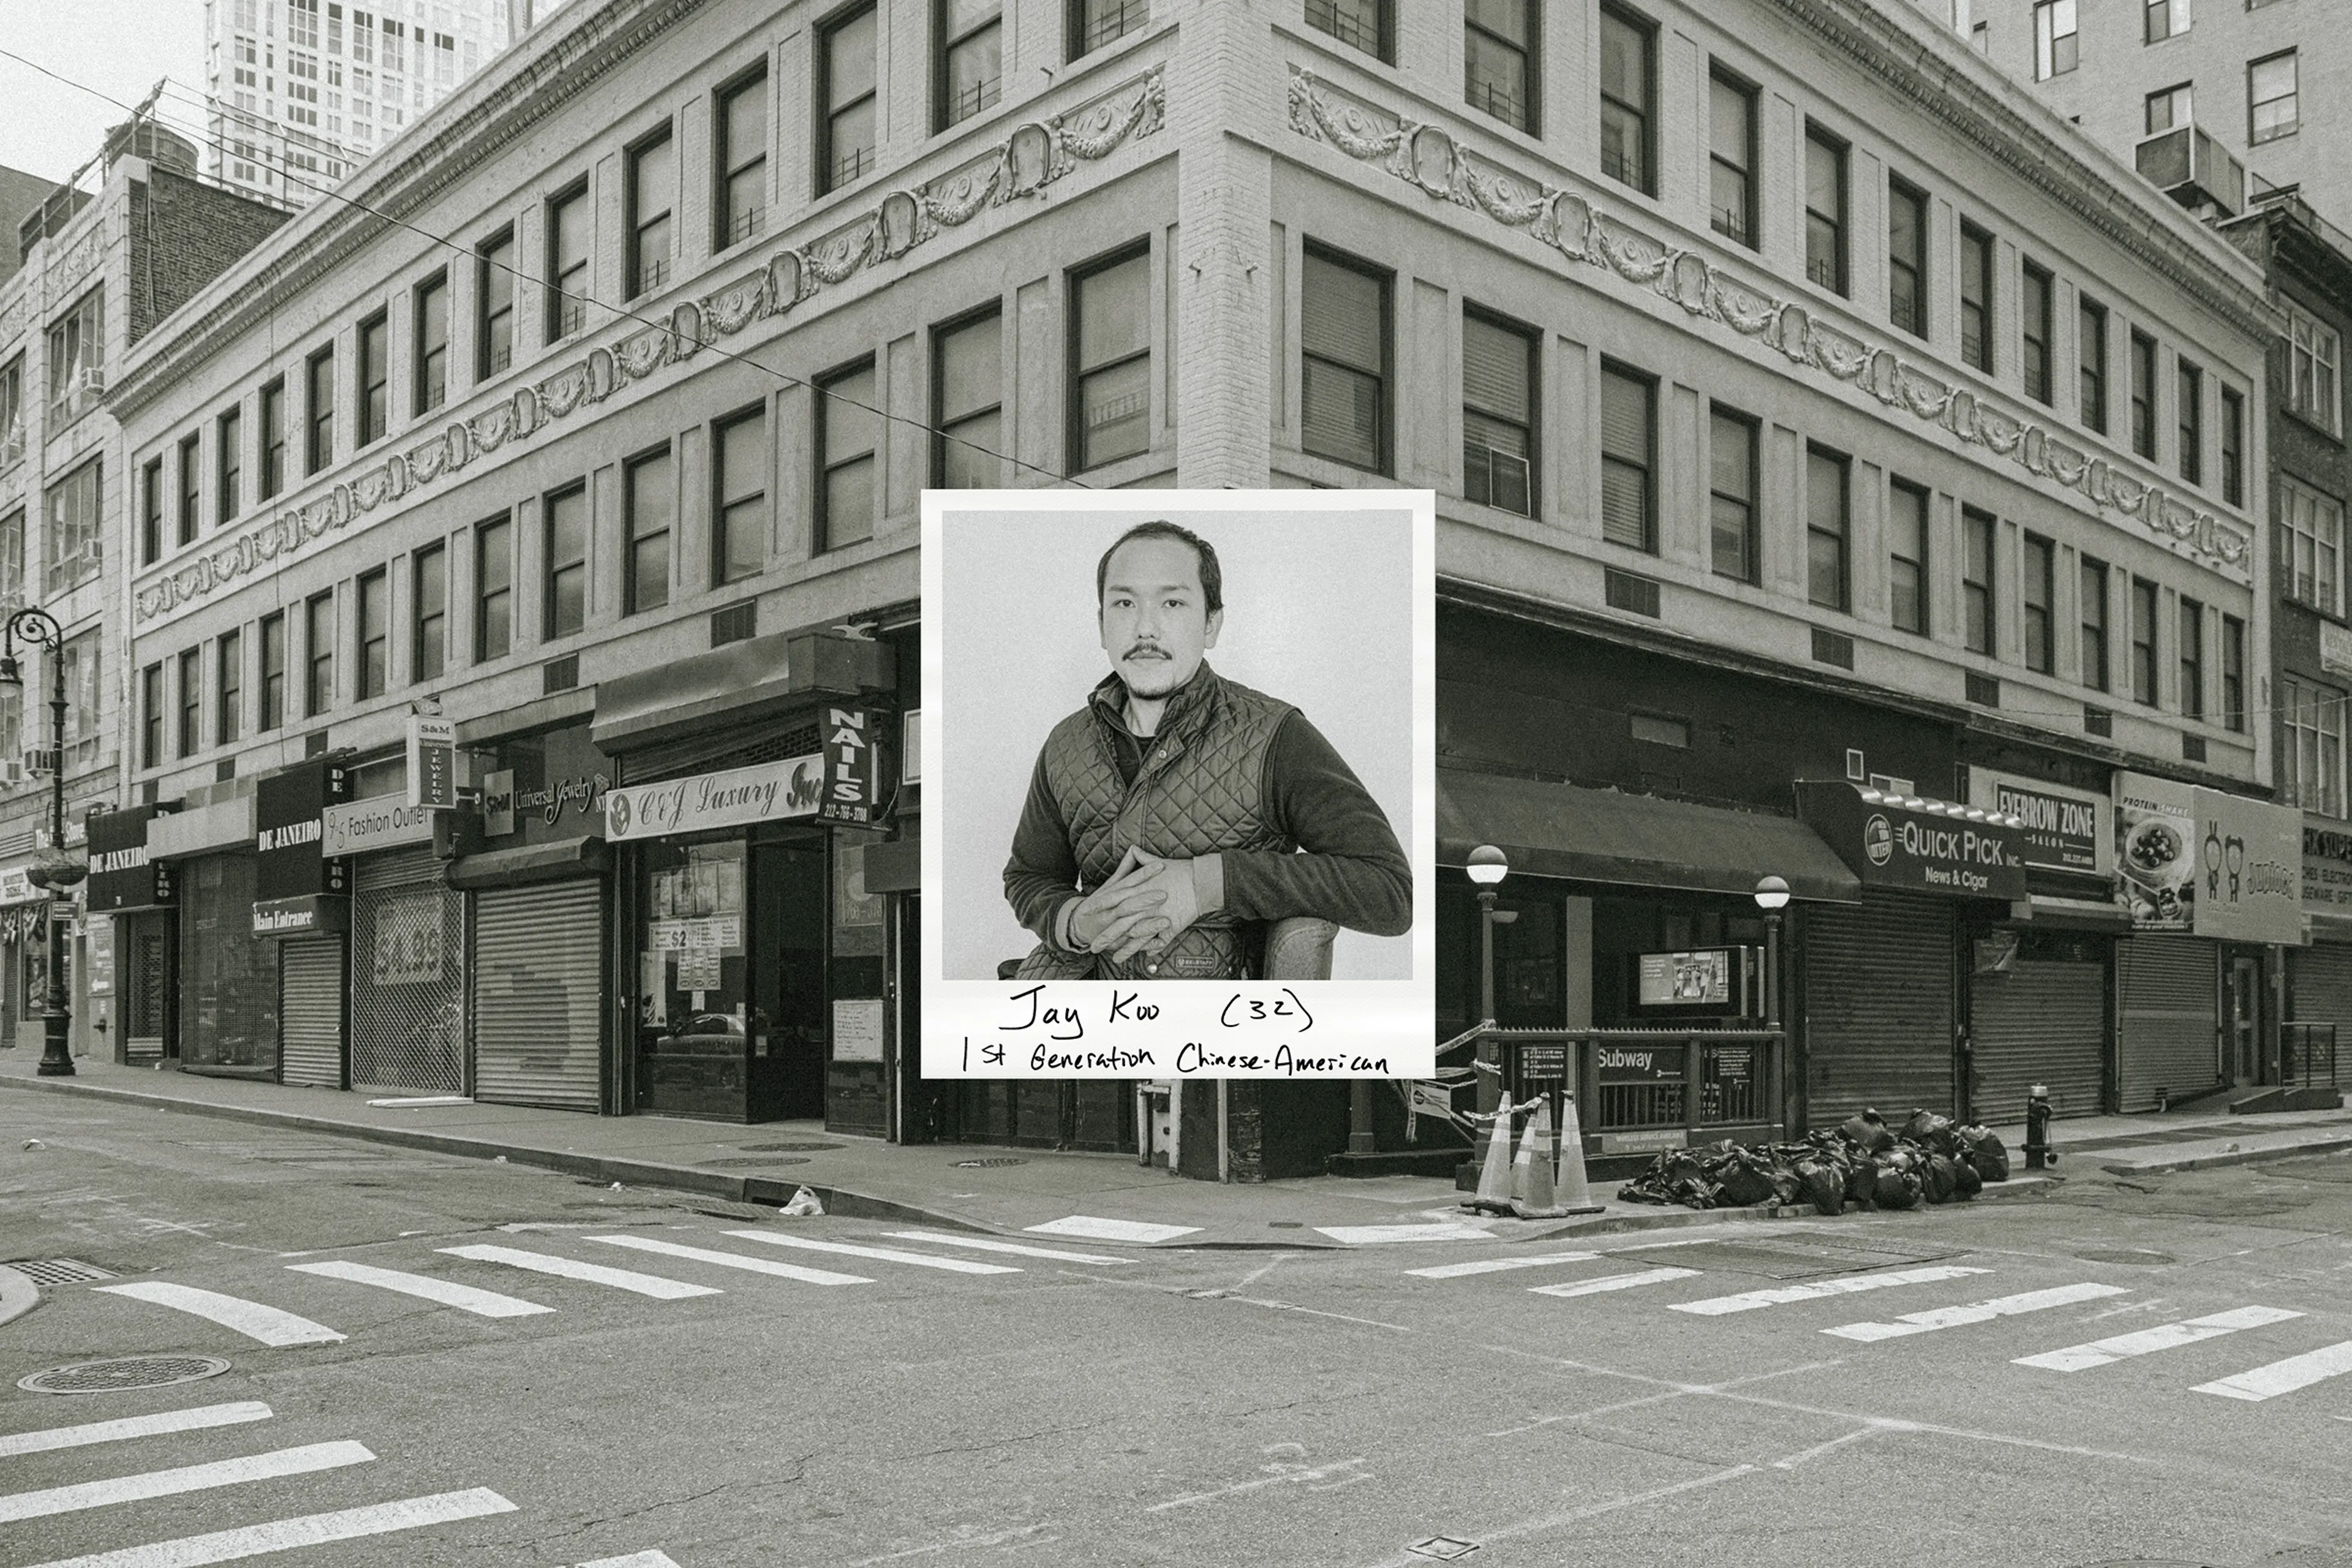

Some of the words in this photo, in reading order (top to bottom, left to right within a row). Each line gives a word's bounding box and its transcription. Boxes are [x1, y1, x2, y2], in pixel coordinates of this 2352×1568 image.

[421, 724, 450, 734] S&M
[830, 708, 866, 802] NAILS
[430, 748, 443, 804] JEWELRY
[515, 783, 555, 810] Universal
[545, 777, 594, 825] Jewelry
[696, 776, 782, 816] Luxury
[2123, 796, 2158, 811] PROTEIN
[349, 812, 390, 837] Fashion
[1999, 790, 2059, 832] EYEBROW
[2061, 802, 2094, 839] ZONE
[258, 829, 274, 851] DE
[275, 818, 322, 848] JANEIRO
[1903, 821, 1959, 861] QUICK
[1963, 830, 2003, 865] PICK
[2031, 834, 2064, 848] SALON
[90, 854, 104, 874] DE
[105, 845, 150, 872] JANEIRO
[1925, 866, 1951, 885] News
[1953, 869, 1960, 886] &
[1962, 870, 1989, 892] Cigar
[254, 911, 274, 930] Main
[274, 910, 313, 929] Entrance
[1598, 1049, 1653, 1071] Subway
